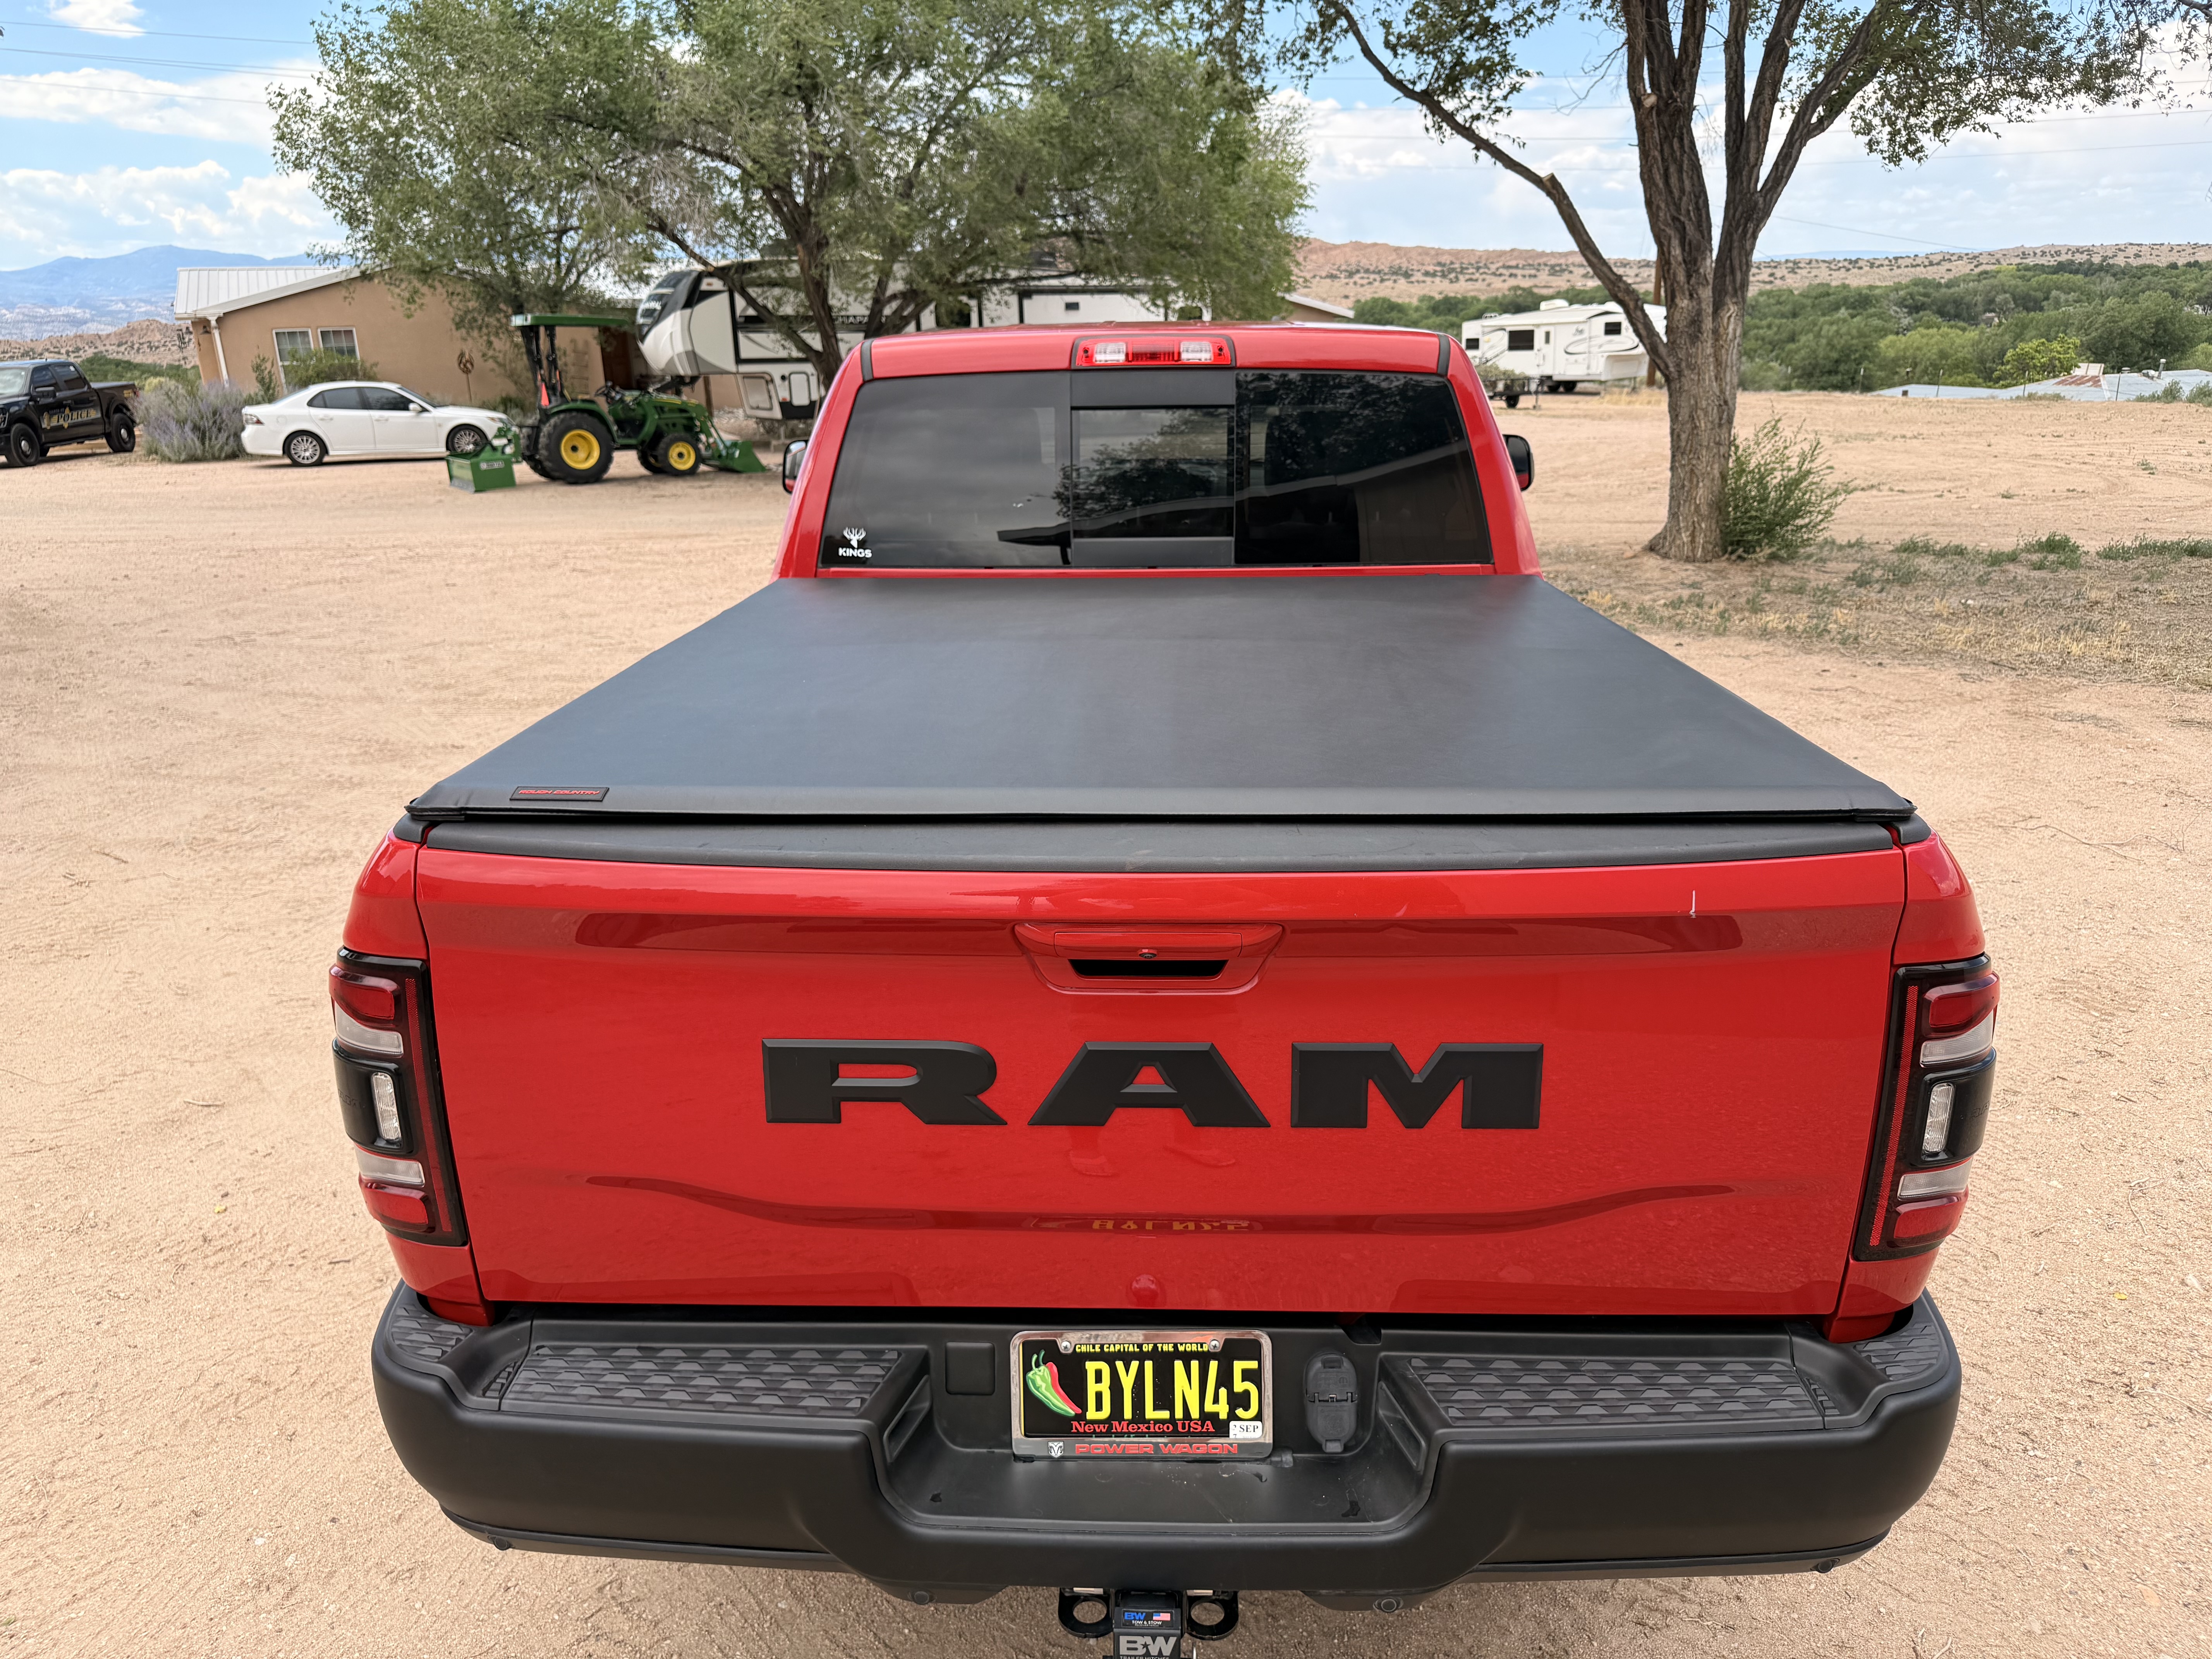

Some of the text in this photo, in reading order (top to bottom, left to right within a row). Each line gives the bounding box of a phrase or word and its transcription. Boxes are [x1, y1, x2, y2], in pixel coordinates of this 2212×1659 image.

[838, 547, 872, 558] KINGS
[761, 1038, 1544, 1128] RAM
[1085, 1360, 1259, 1420] BYLN45
[1071, 1421, 1215, 1432] New Mexico USA
[1075, 1444, 1238, 1454] POWER WAGON
